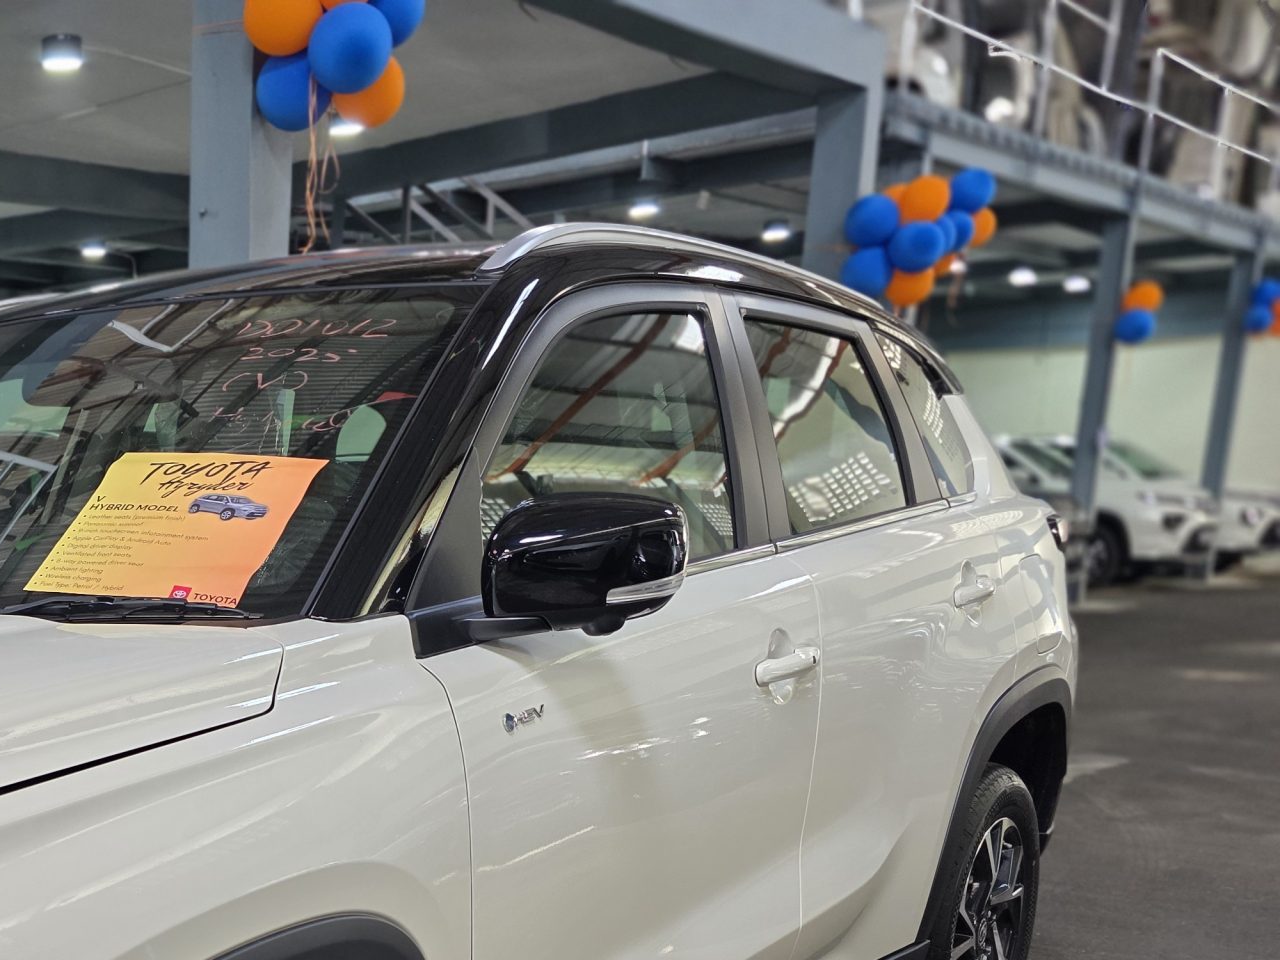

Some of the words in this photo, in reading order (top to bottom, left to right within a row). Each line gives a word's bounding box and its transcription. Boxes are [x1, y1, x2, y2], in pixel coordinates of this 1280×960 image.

[240, 347, 358, 362] 2025
[140, 461, 273, 485] TOYOTA
[157, 474, 254, 499] Hyryder
[97, 495, 107, 503] V
[89, 503, 135, 512] HYBRID
[135, 504, 180, 513] MODEL
[93, 535, 120, 543] CarPlay
[127, 536, 155, 545] Android
[184, 534, 209, 542] system
[66, 542, 89, 550] Digital
[110, 544, 133, 552] display
[76, 559, 107, 567] powered
[51, 565, 79, 573] Ambient
[79, 566, 104, 575] lighting
[72, 574, 102, 583] charging
[102, 584, 125, 592] Hybrid
[193, 592, 237, 606] TOYOTA
